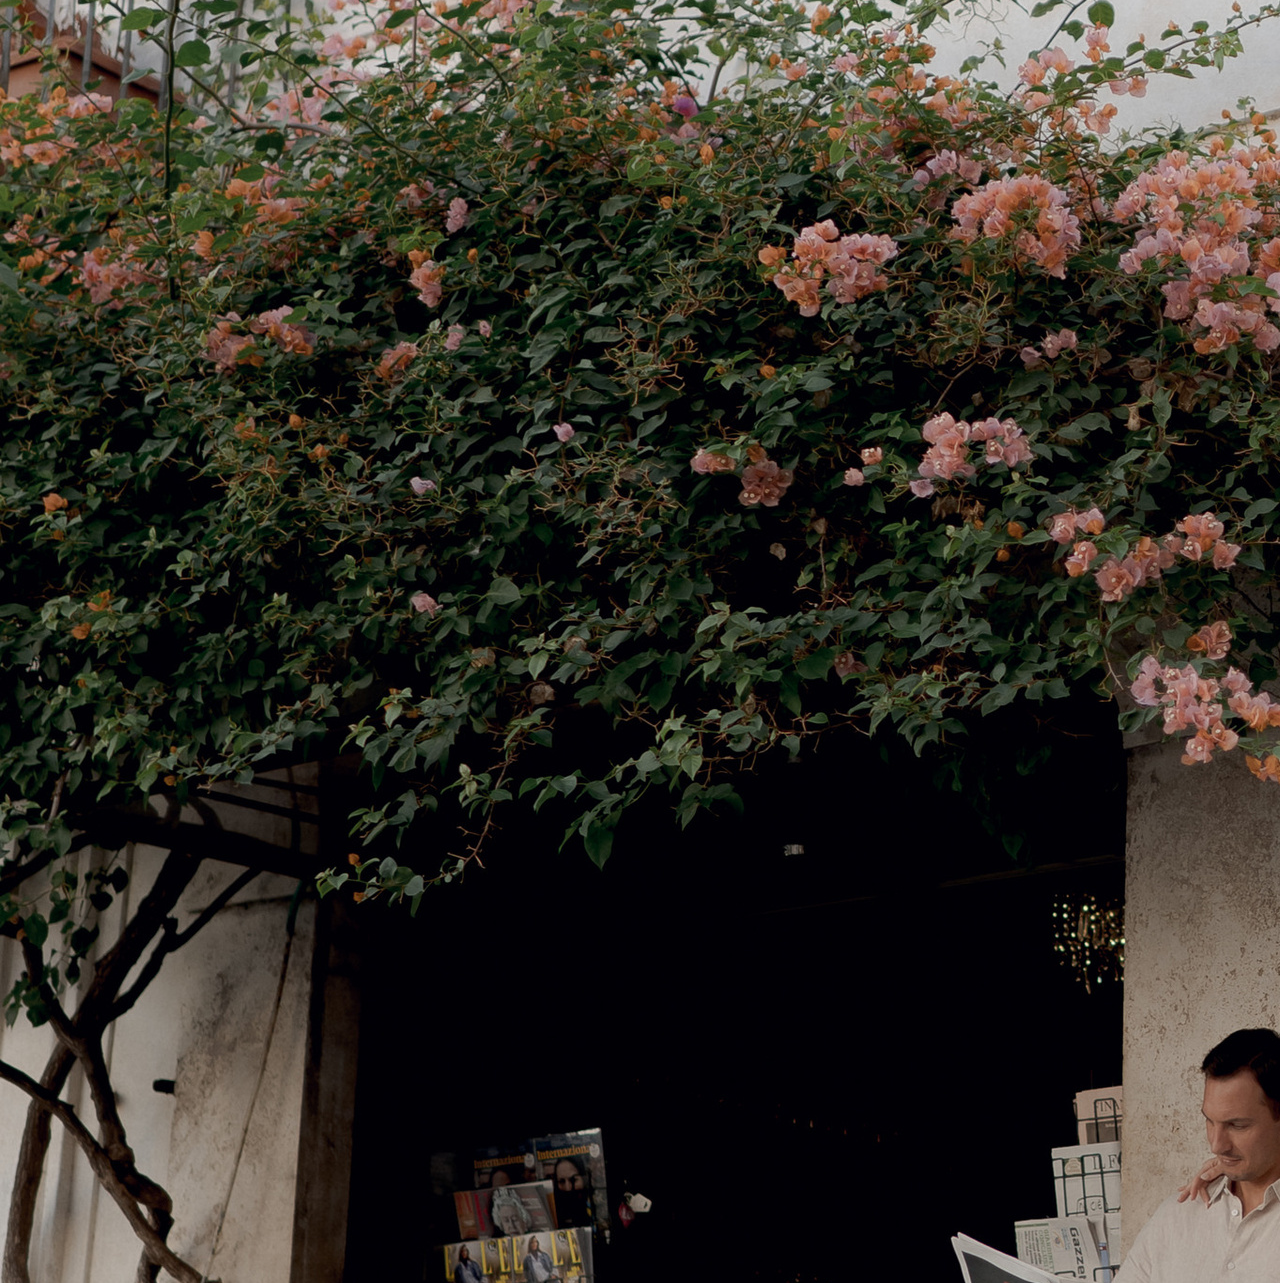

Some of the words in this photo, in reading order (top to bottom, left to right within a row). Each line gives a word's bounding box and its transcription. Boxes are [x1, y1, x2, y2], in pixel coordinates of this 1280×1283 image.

[474, 1155, 525, 1169] Internaziona
[537, 1144, 591, 1161] Internaziona
[444, 1237, 511, 1282] ELE
[512, 1229, 581, 1274] ELE
[1069, 1227, 1087, 1279] Gazzet
